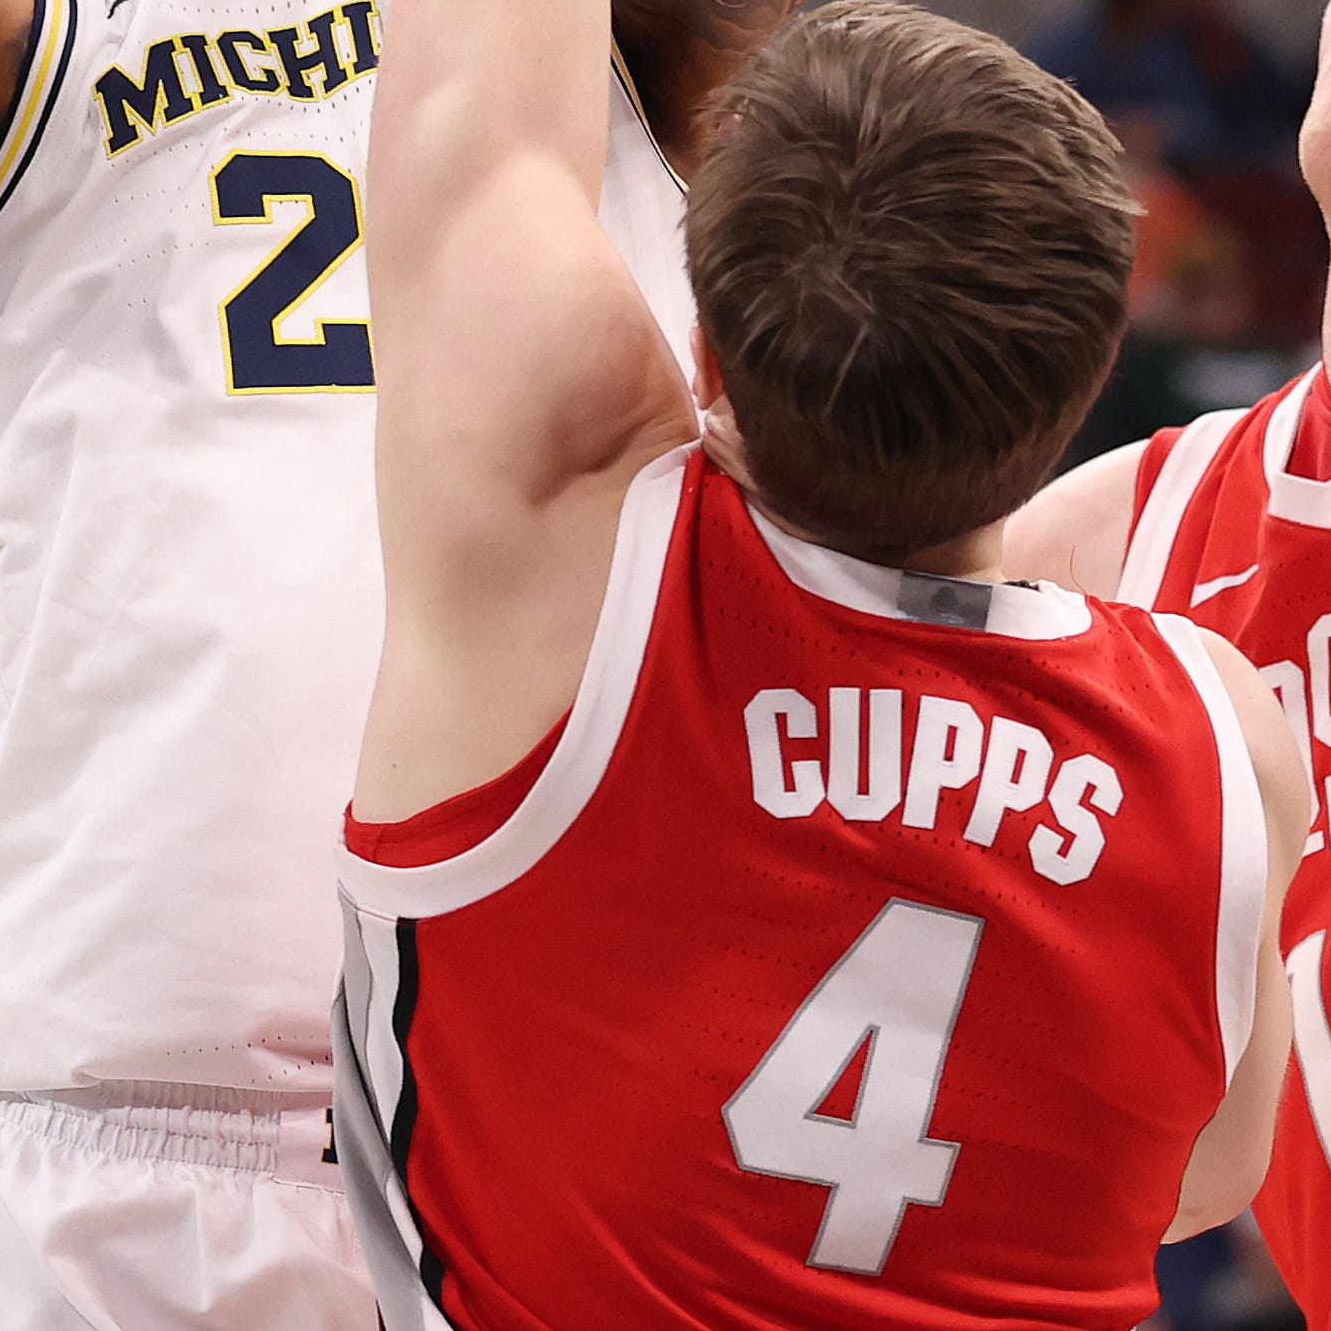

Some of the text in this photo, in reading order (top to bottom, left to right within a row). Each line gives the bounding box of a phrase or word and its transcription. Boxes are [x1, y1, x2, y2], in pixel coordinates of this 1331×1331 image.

[93, 0, 382, 160] MICHI
[209, 148, 378, 396] 2
[742, 686, 1125, 887] CUPPS
[721, 896, 987, 1277] 4
